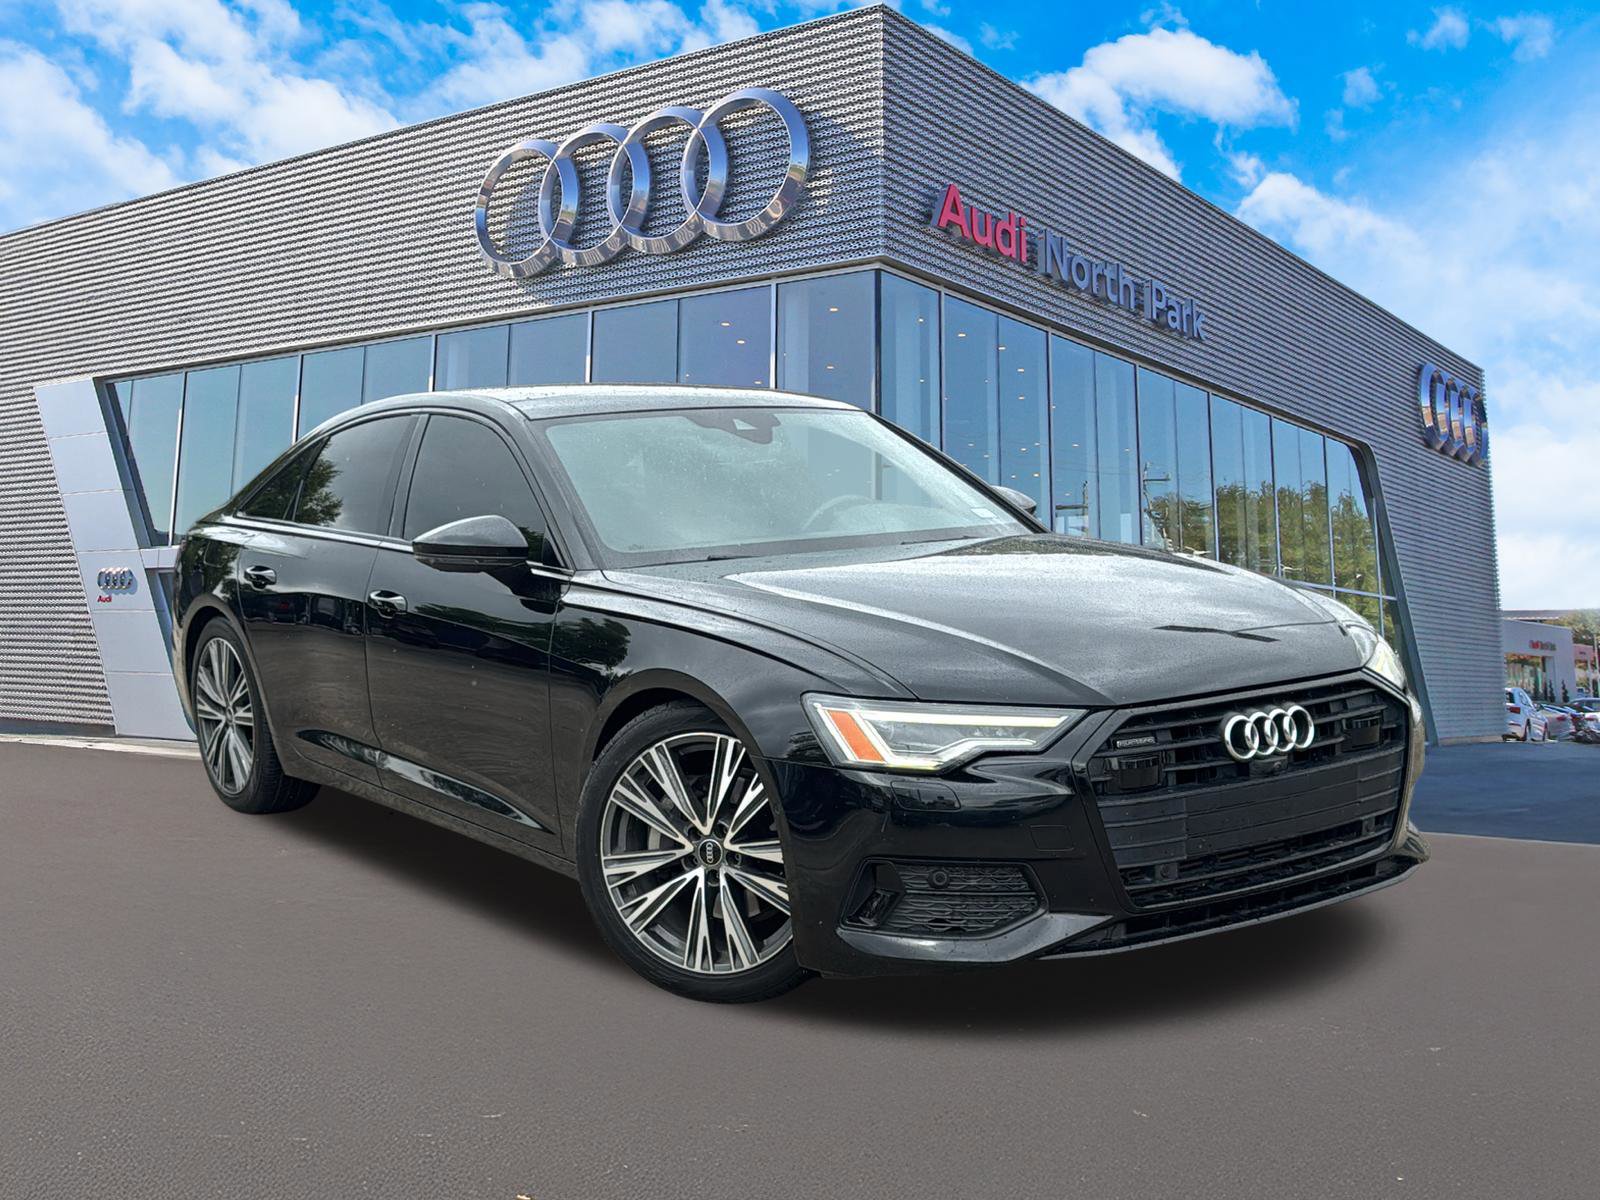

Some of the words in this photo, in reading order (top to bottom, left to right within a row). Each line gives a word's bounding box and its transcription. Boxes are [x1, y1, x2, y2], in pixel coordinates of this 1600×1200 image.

[935, 183, 1027, 263] Audi
[1041, 230, 1137, 312] North
[1147, 279, 1207, 341] Park
